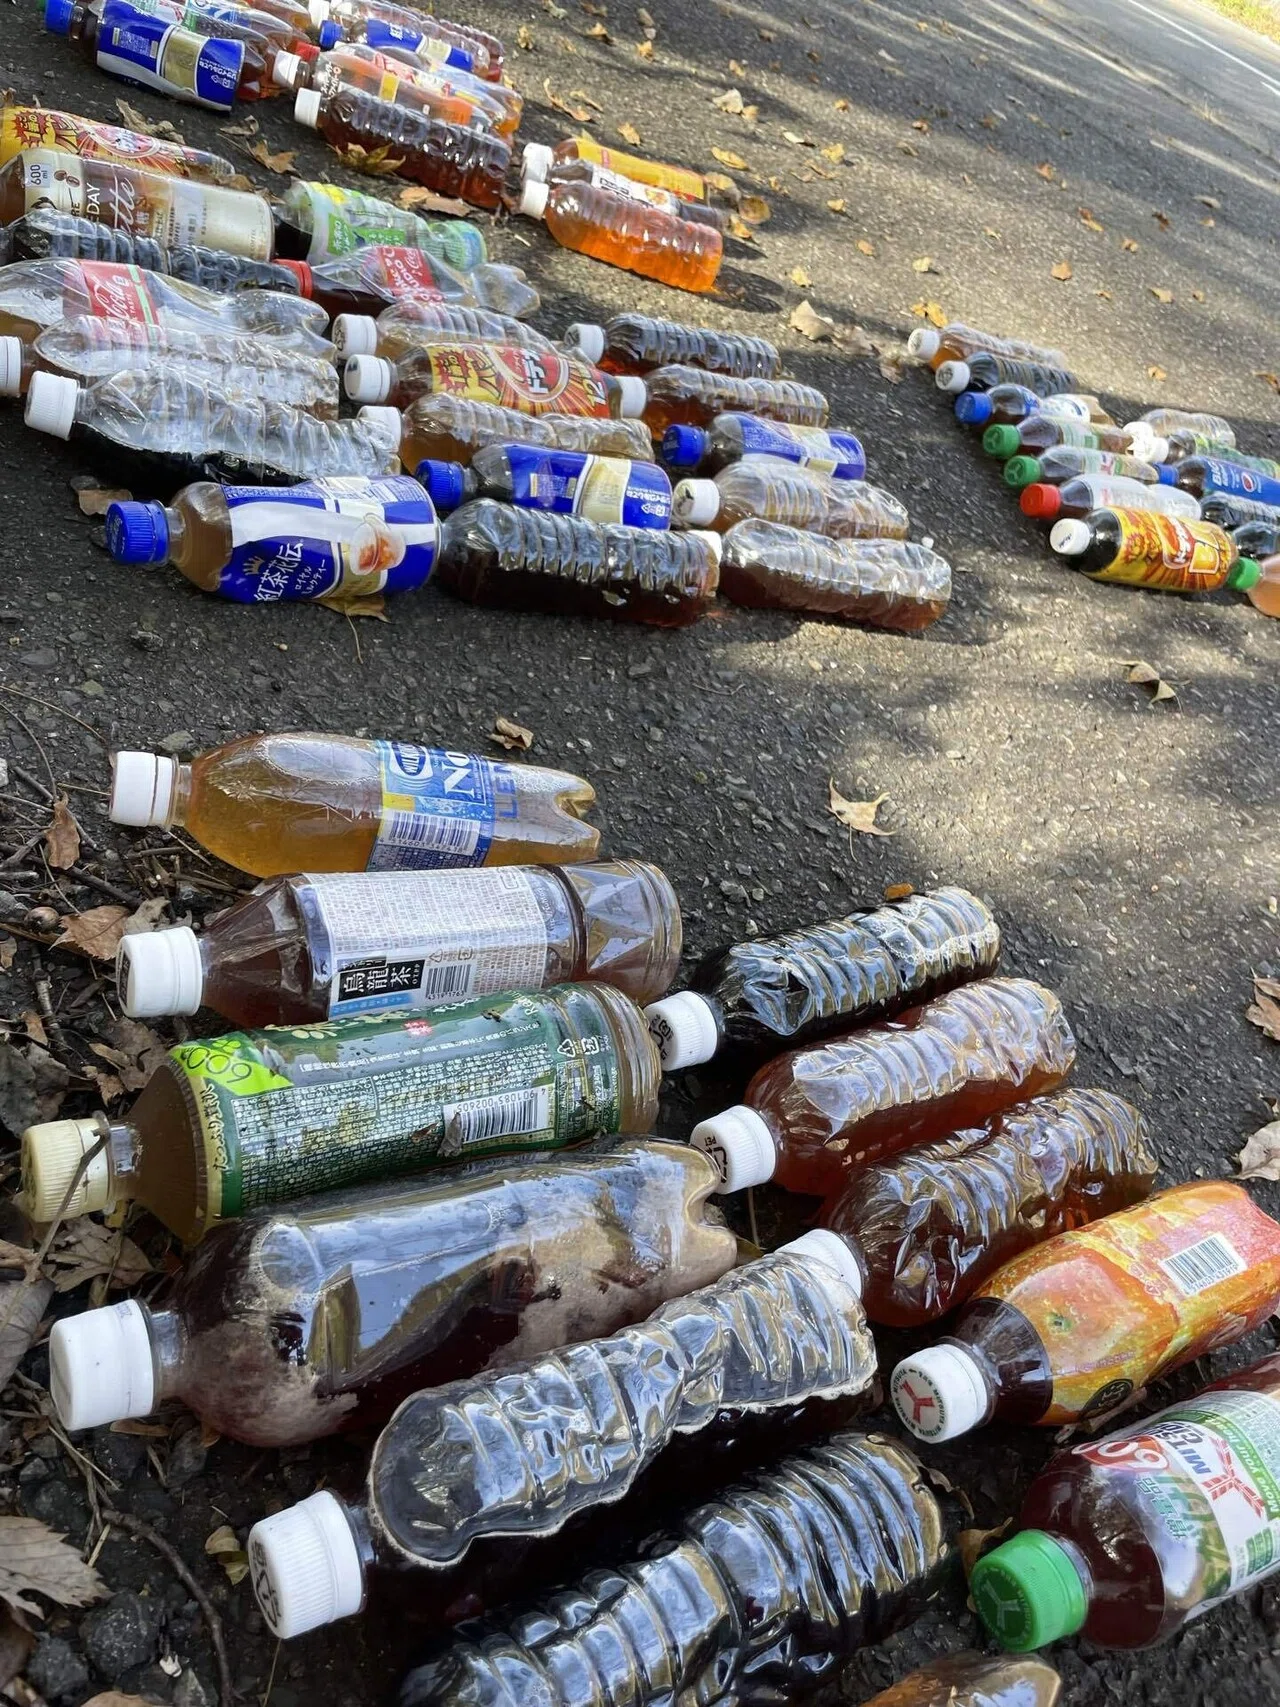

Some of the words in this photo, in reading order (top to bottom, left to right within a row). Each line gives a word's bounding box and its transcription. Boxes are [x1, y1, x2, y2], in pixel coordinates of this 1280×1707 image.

[29, 164, 42, 186] 600
[86, 182, 101, 213] DAY
[254, 542, 304, 602] 紅茶花伝
[294, 566, 313, 592] ロイヤル
[342, 965, 411, 992] 烏龍茶
[187, 1046, 254, 1086] 600
[455, 1096, 494, 1113] 002605
[497, 1088, 535, 1104] 901085
[705, 1136, 717, 1146] PET
[1235, 1441, 1261, 1476] your
[1134, 1472, 1191, 1542] 増量品
[1253, 1473, 1280, 1514] Move
